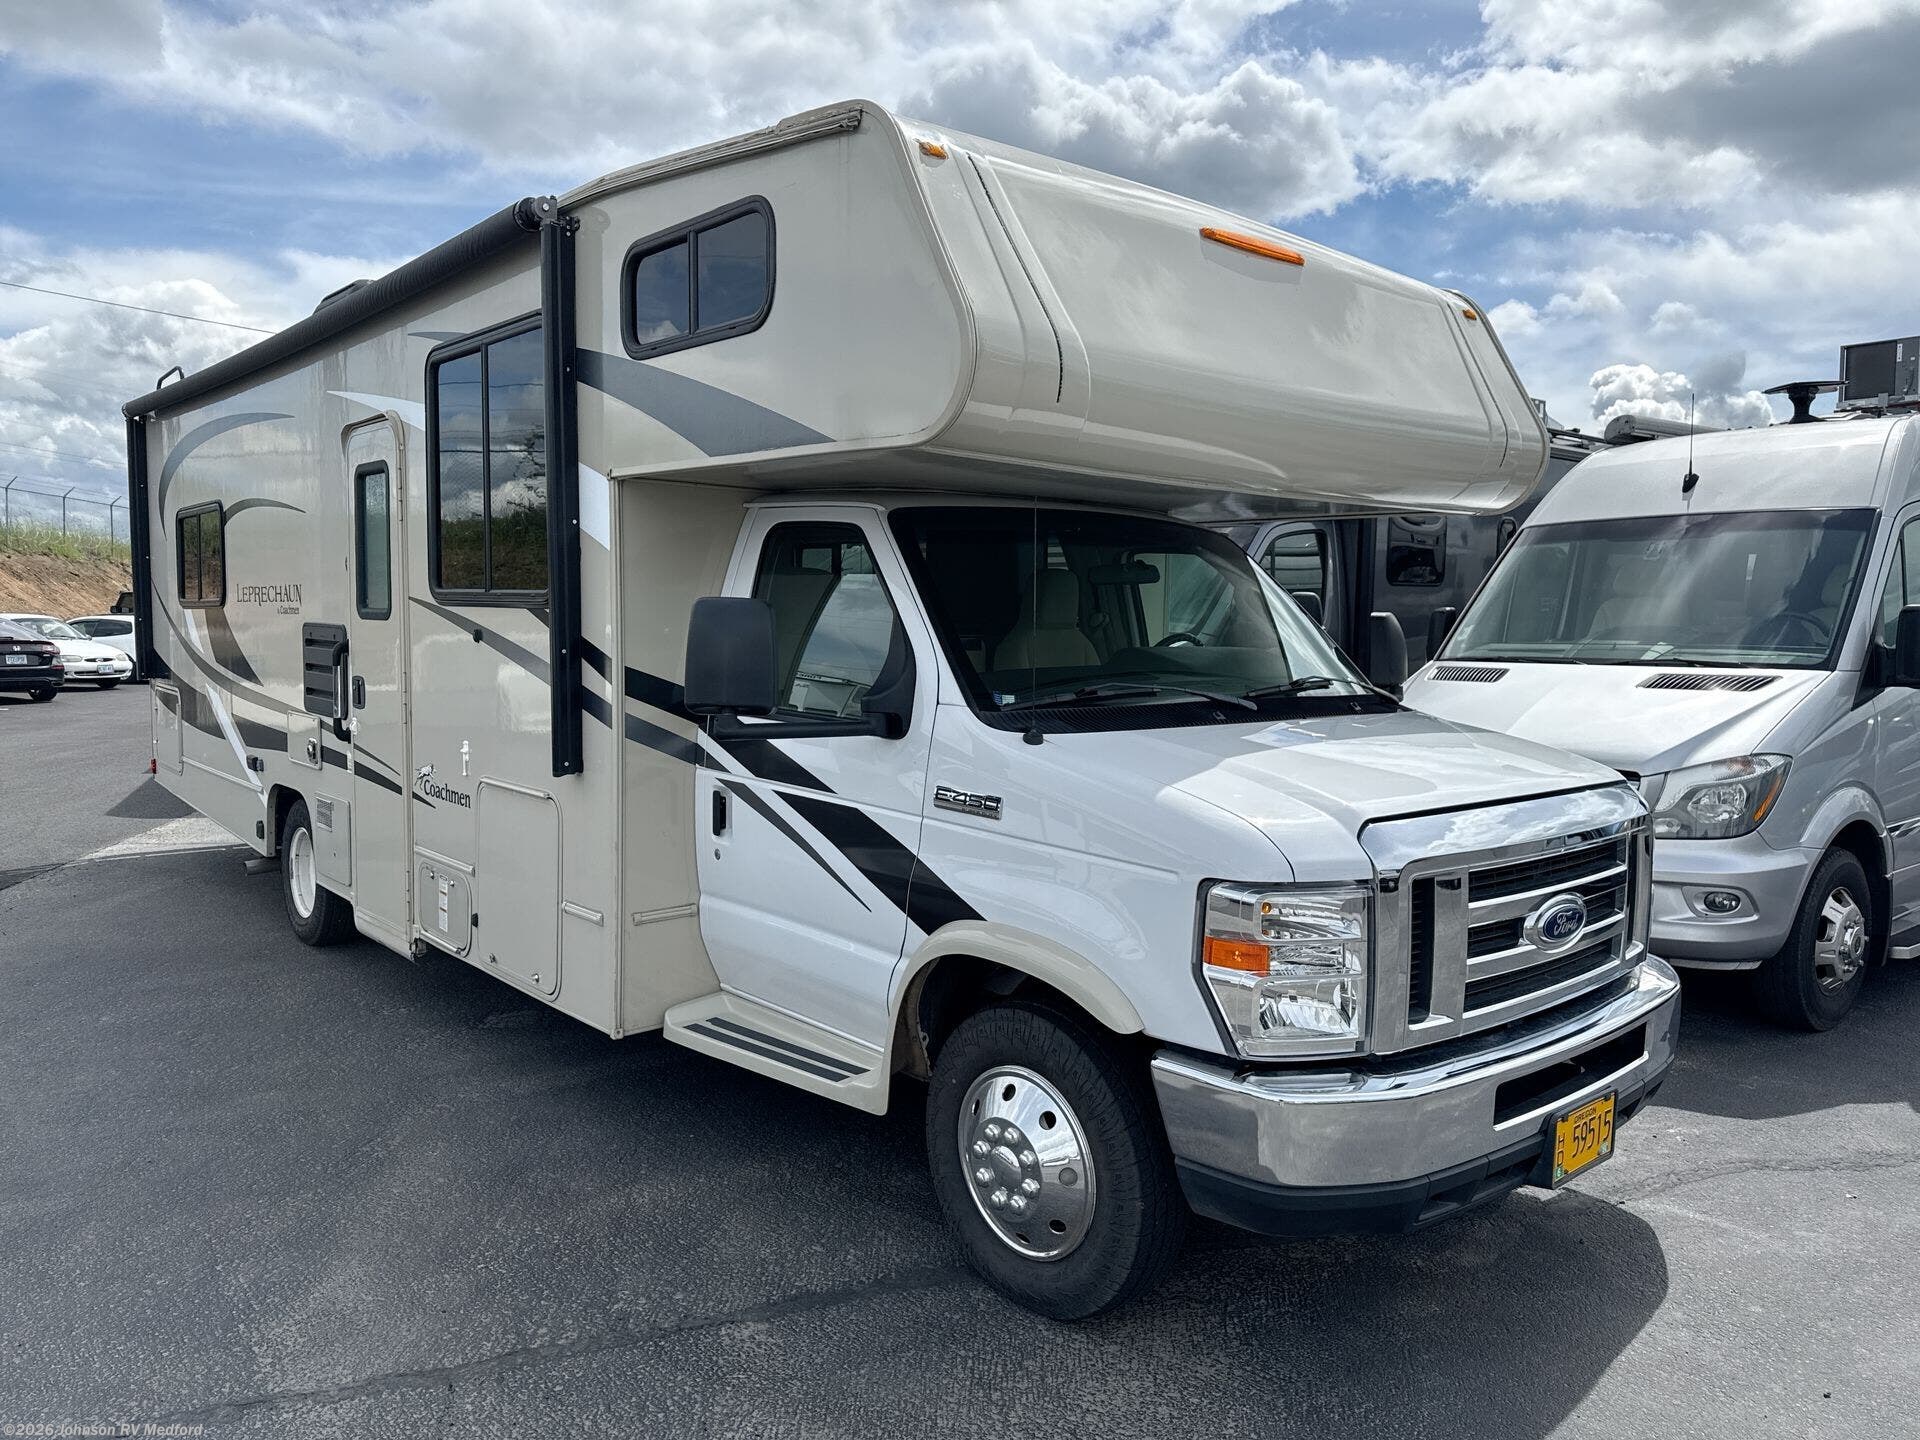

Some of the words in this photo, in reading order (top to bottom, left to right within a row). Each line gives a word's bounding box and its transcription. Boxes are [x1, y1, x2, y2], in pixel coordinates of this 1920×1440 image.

[236, 583, 302, 607] LEPRECHAUN
[423, 779, 471, 809] Coachmen
[1553, 910, 1580, 936] Ford
[1571, 1108, 1613, 1159] 59515
